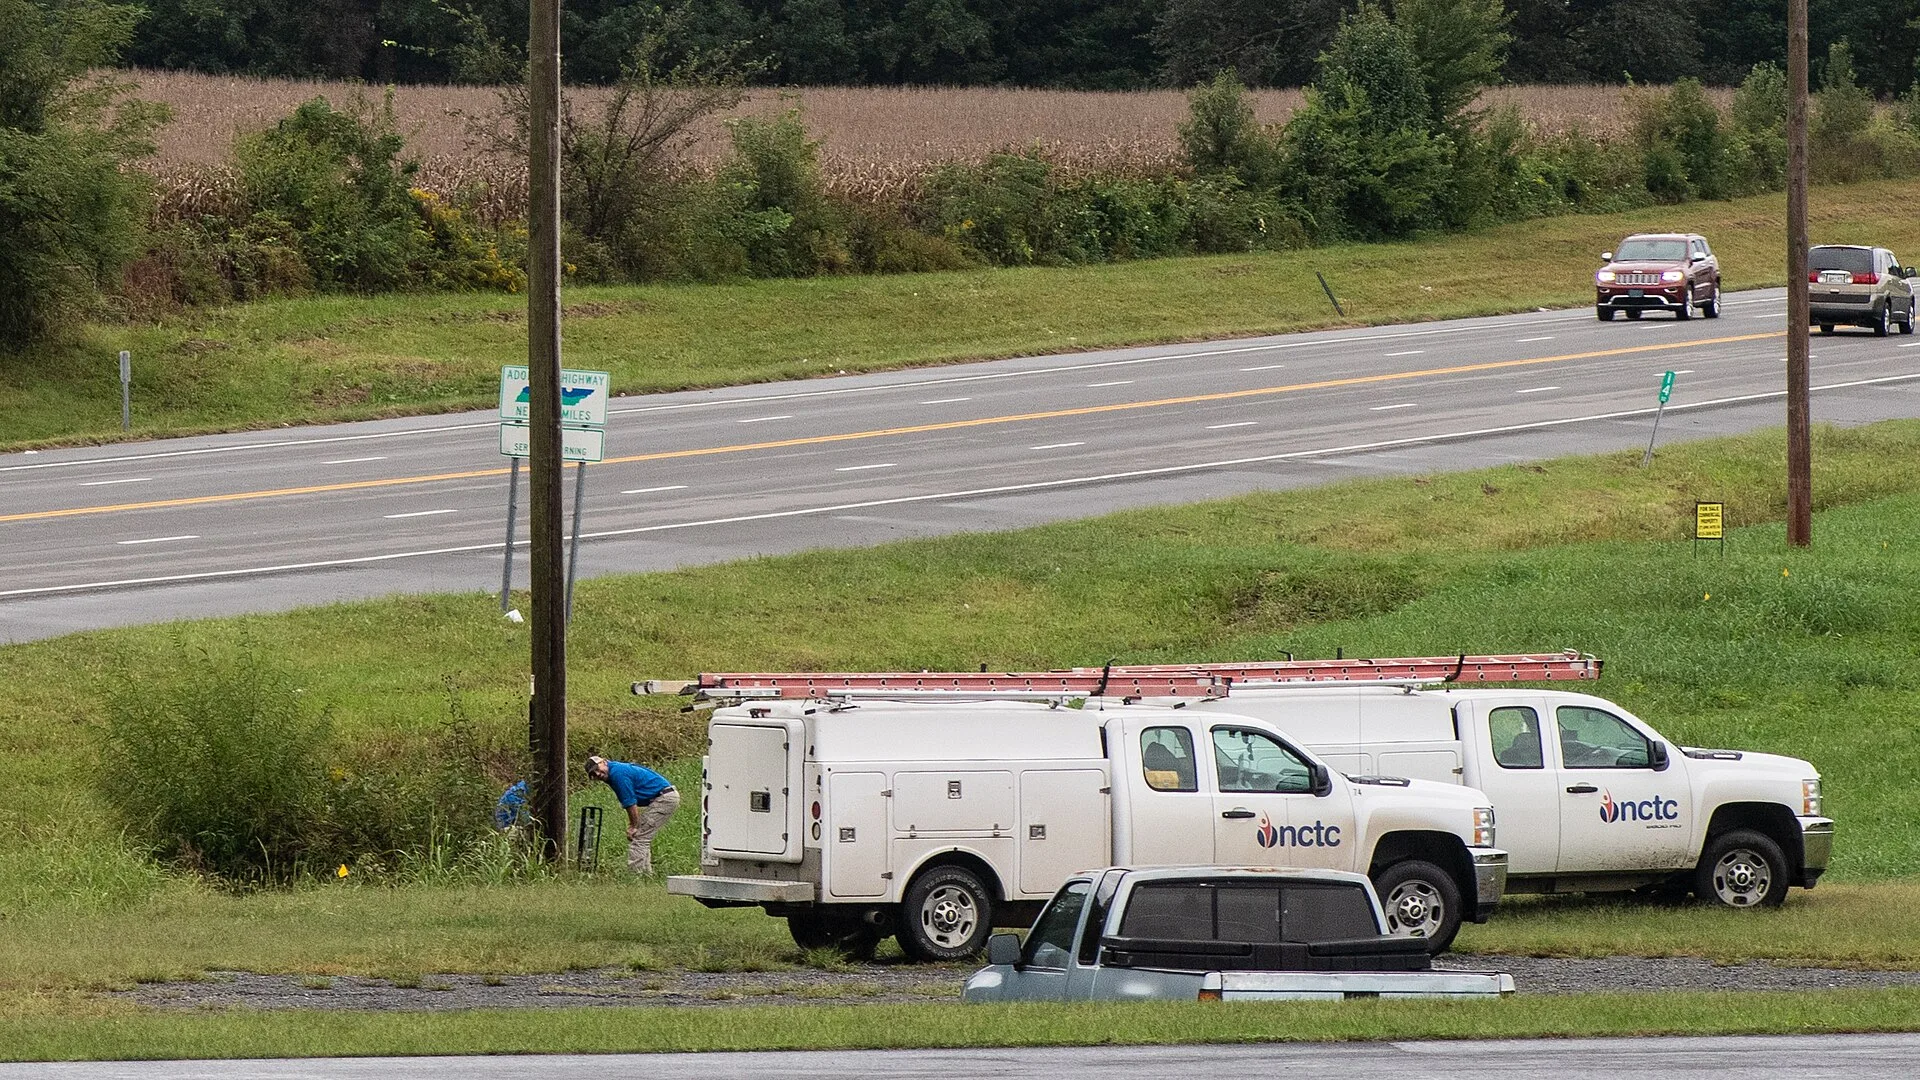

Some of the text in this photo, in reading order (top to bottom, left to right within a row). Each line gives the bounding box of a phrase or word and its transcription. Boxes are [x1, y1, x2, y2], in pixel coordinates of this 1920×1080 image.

[507, 369, 604, 386] ADO HIGHWAY
[516, 406, 591, 421] NE MILES
[564, 446, 587, 456] RNING
[1620, 795, 1678, 821] nctc
[1280, 820, 1340, 847] nctc
